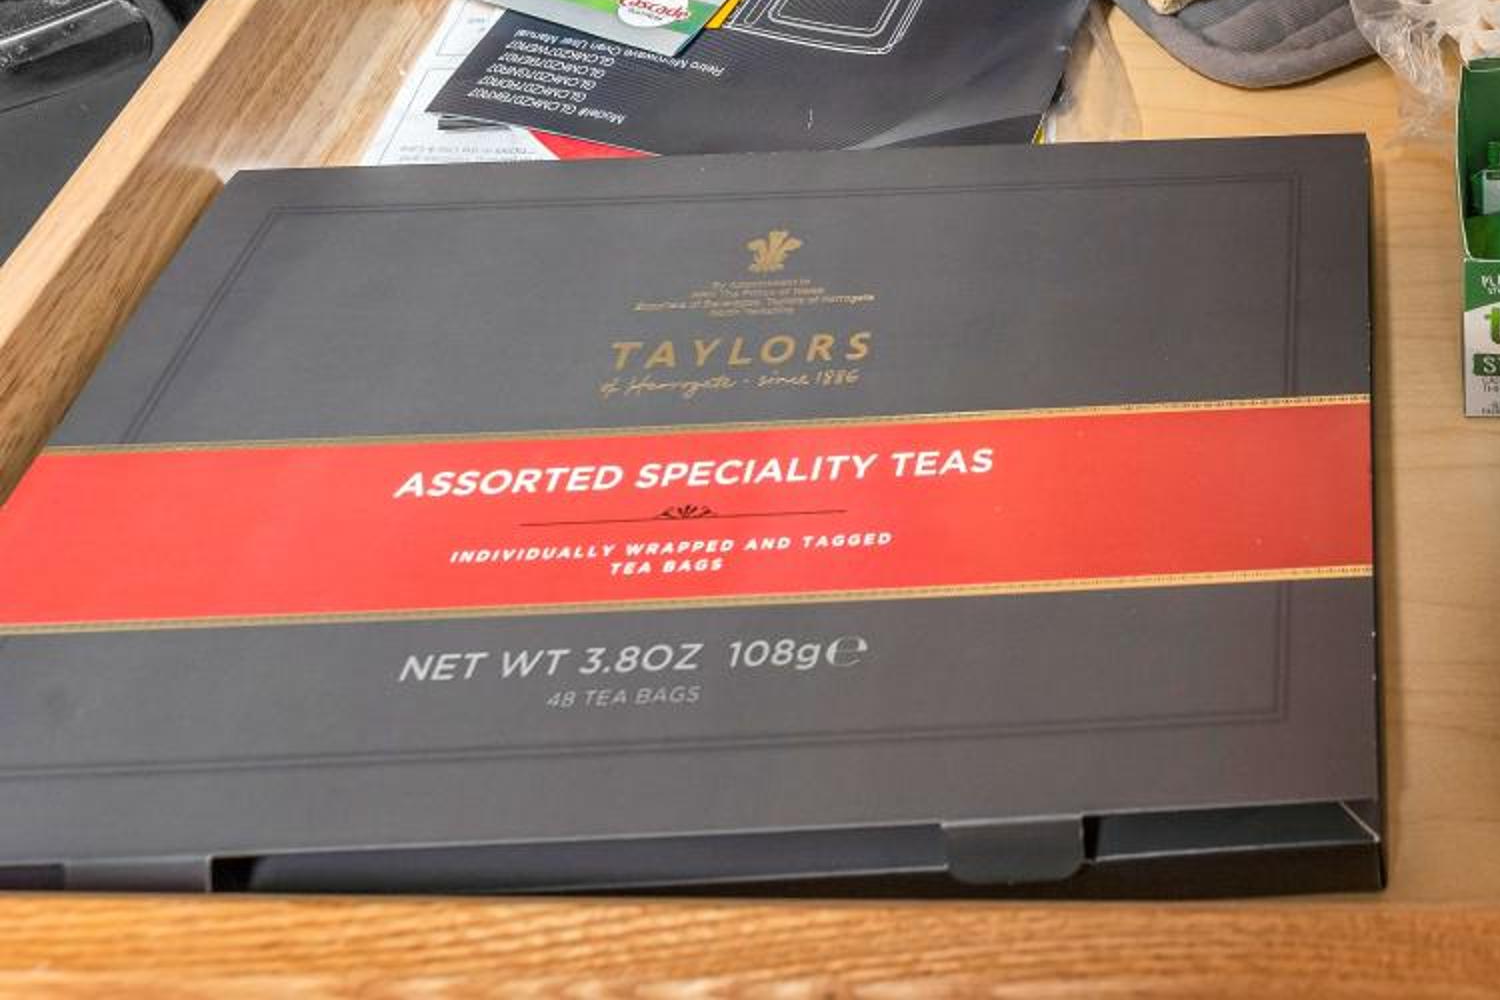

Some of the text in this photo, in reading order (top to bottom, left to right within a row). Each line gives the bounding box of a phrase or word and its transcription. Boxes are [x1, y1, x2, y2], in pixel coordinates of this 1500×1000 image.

[610, 331, 873, 371] TAYLORS
[756, 370, 810, 388] since
[394, 448, 994, 499] ASSORTED SPECIALITY TEAS
[450, 531, 893, 564] INDIVIDUALLY WRAPPED AND TAGGED
[610, 557, 724, 577] TEA BAGS
[399, 651, 487, 682] NET
[499, 648, 569, 678] WT
[578, 642, 705, 676] 3.8OZ
[546, 684, 702, 709] 48 TEA BAGS
